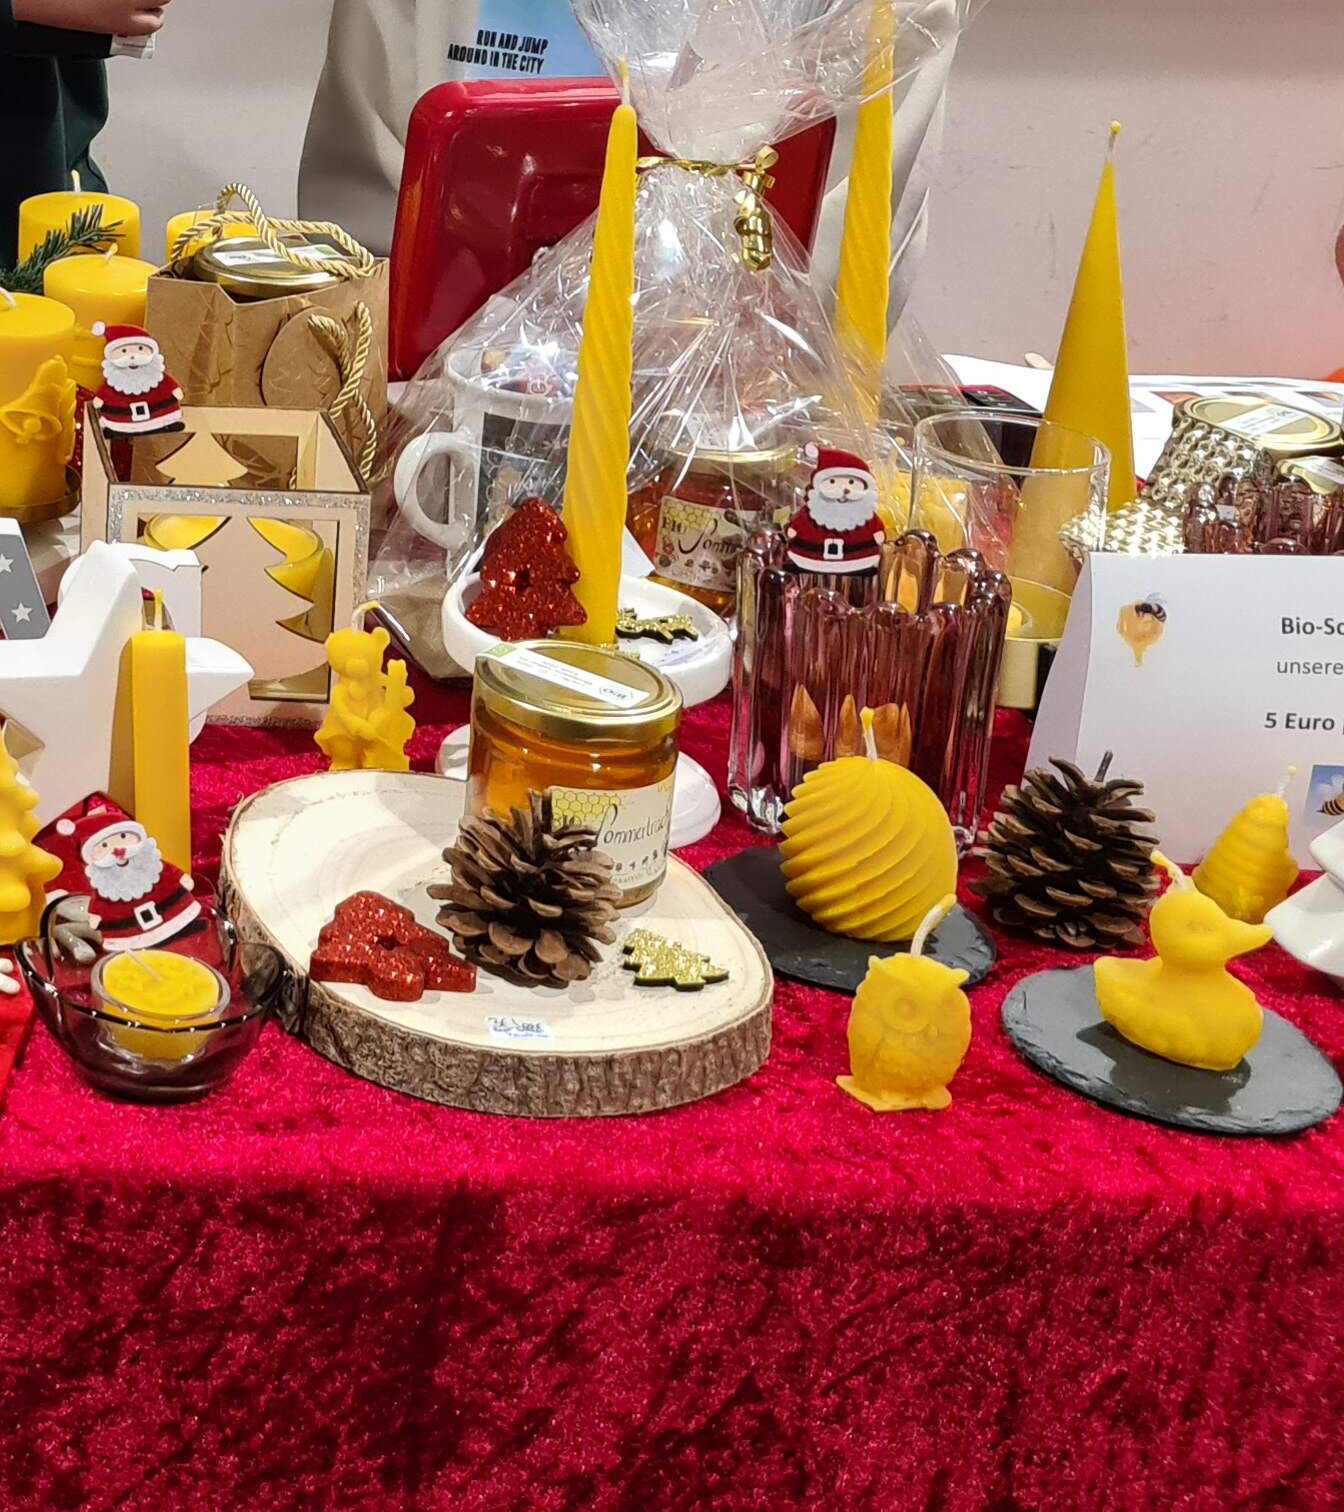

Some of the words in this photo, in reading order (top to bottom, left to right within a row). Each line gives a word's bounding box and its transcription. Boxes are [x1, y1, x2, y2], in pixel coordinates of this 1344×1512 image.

[477, 29, 497, 48] RUN
[498, 32, 518, 51] AND
[519, 36, 549, 56] JUMP
[447, 43, 488, 66] AROUND
[489, 50, 500, 68] IN
[501, 51, 519, 71] THE
[519, 54, 545, 75] CITY
[1264, 712, 1277, 729] 5
[1285, 712, 1336, 731] Euro
